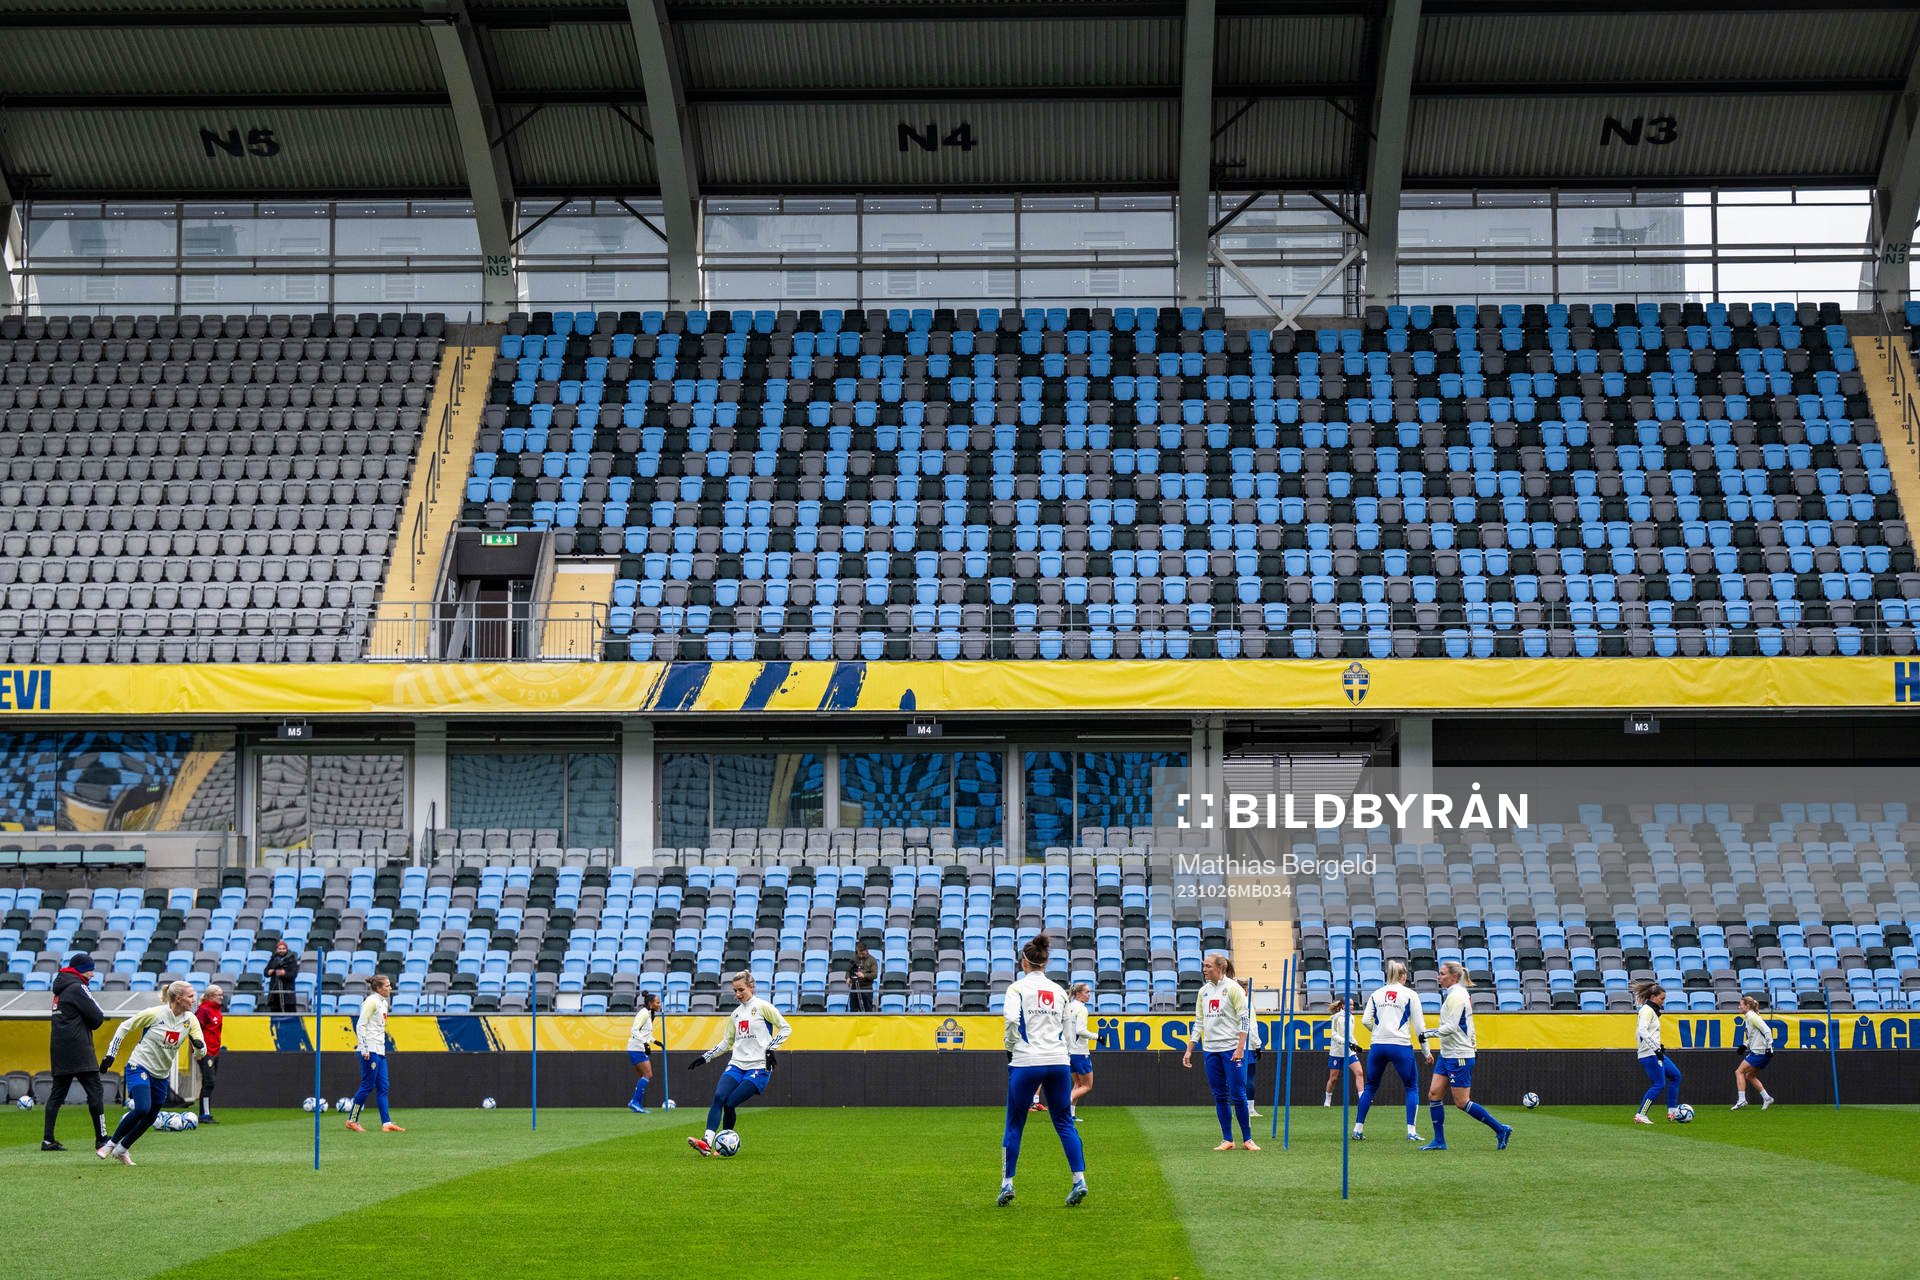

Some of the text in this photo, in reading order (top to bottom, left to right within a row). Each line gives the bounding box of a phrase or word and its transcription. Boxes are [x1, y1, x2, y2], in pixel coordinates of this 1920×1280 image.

[1600, 116, 1678, 146] N3
[200, 127, 280, 157] N5
[898, 122, 977, 152] N4
[1887, 243, 1907, 252] N2
[487, 255, 507, 264] N4
[1885, 253, 1905, 264] N3
[489, 265, 509, 276] N5
[0, 670, 52, 710] EVI
[287, 727, 302, 737] M5
[917, 725, 932, 735] M4
[1634, 722, 1649, 732] M3
[1678, 1019, 1721, 1048] VI
